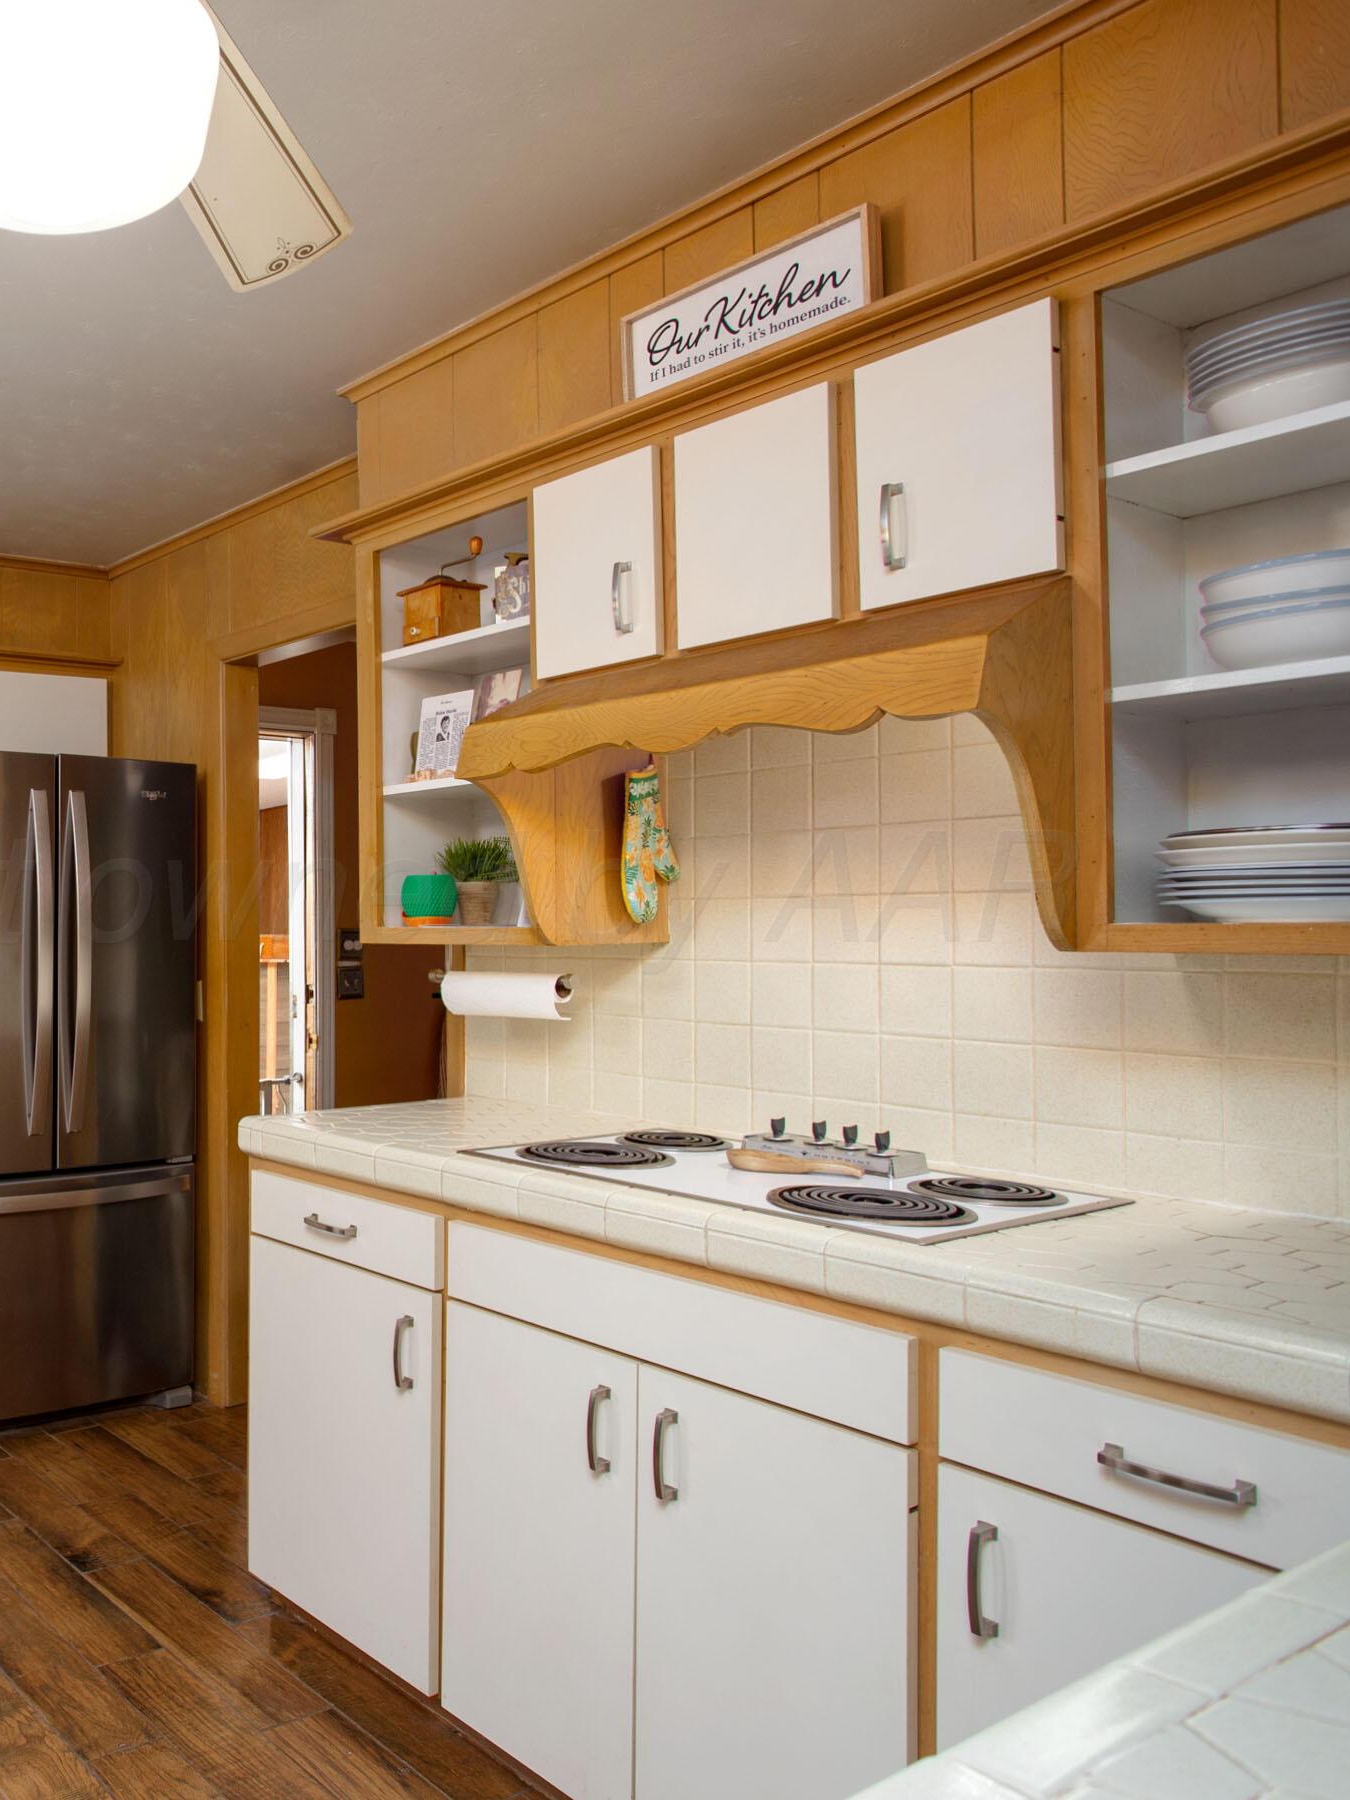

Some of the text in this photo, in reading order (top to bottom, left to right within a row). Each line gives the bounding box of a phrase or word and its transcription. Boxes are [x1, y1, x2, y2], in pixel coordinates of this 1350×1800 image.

[647, 263, 851, 366] Our Kitchen
[650, 368, 660, 382] If
[669, 357, 691, 375] had
[693, 354, 706, 365] to
[708, 343, 729, 359] stir
[748, 327, 767, 343] it's
[769, 295, 851, 334] homemade.
